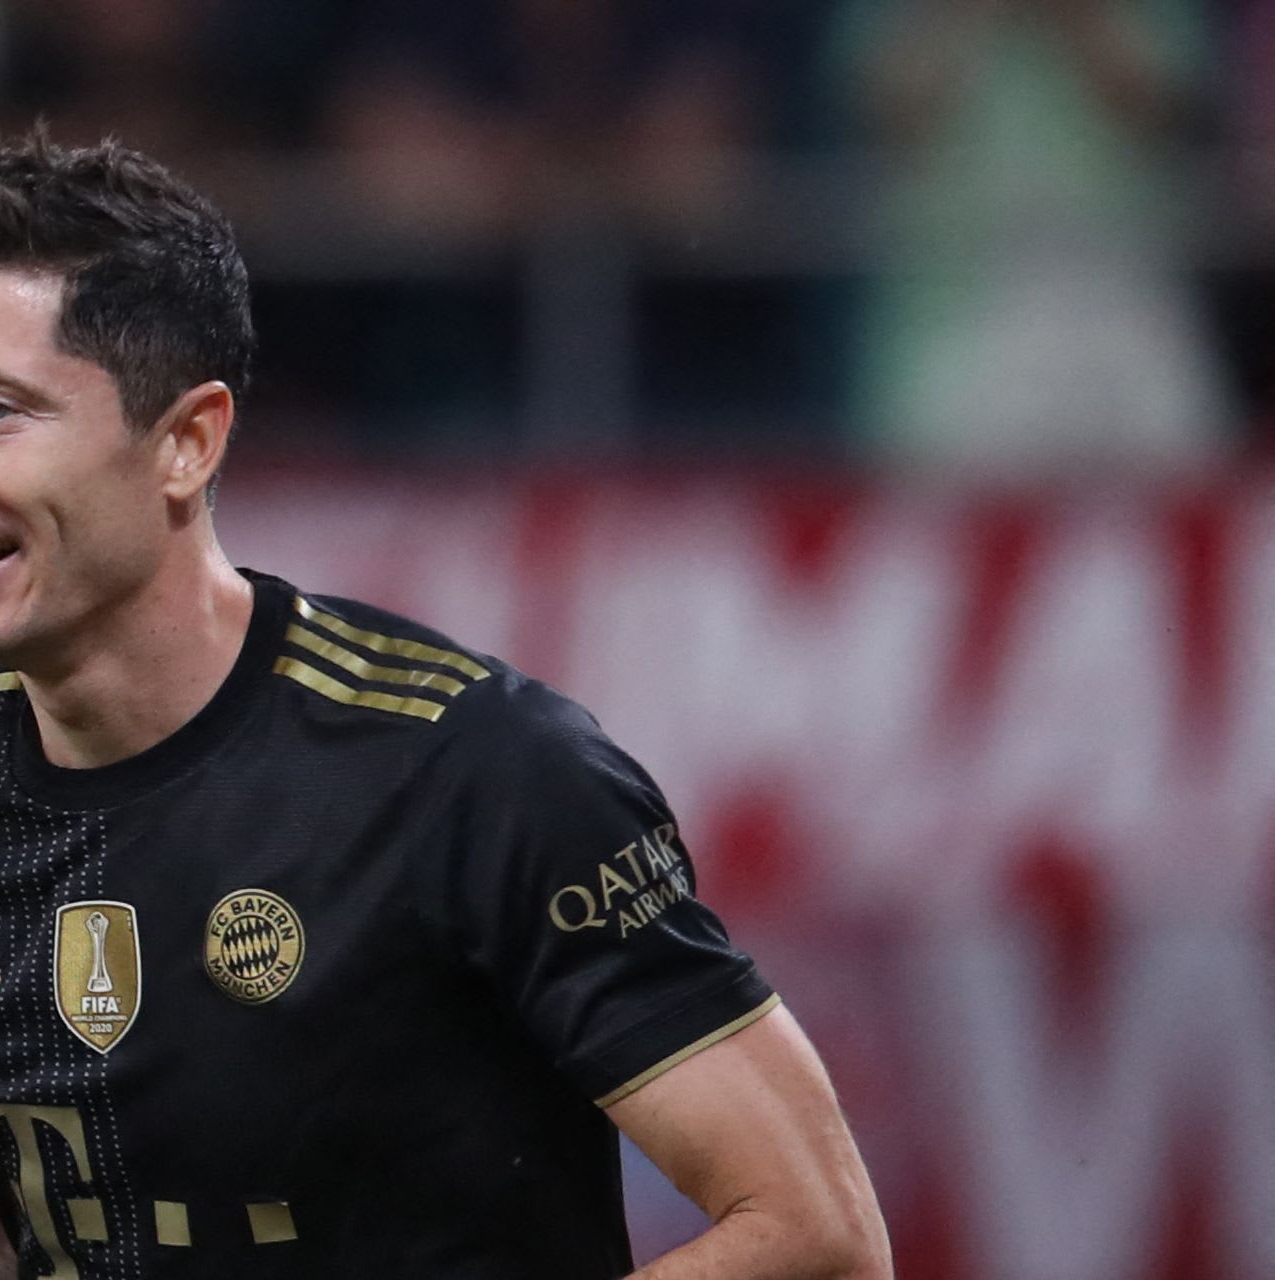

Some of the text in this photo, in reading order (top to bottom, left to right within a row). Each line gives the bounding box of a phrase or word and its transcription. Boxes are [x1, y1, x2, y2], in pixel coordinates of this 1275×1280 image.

[549, 822, 682, 932] QATAR
[211, 898, 296, 941] FC BAYERN
[81, 996, 120, 1014] FIFA
